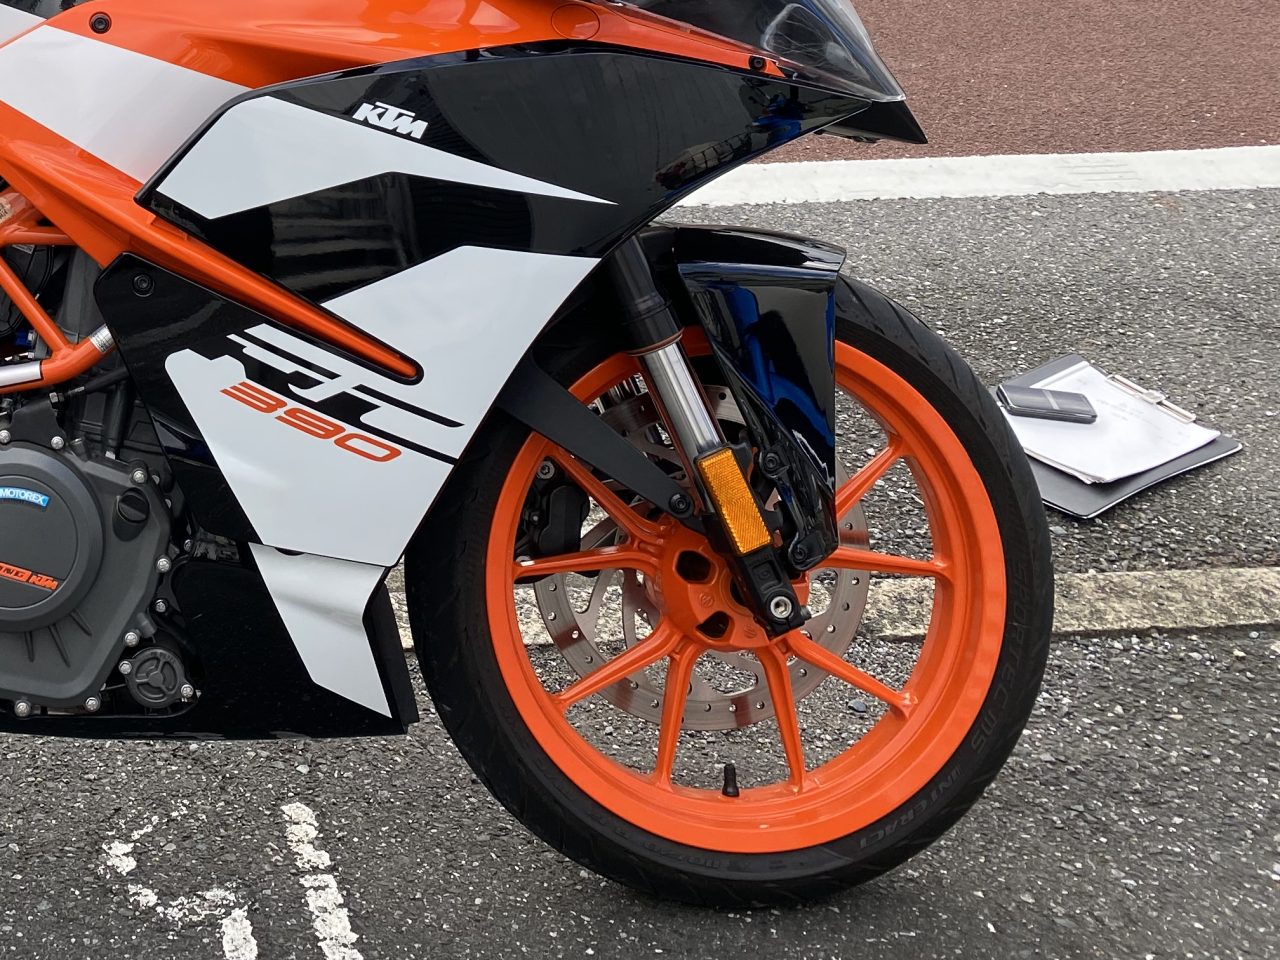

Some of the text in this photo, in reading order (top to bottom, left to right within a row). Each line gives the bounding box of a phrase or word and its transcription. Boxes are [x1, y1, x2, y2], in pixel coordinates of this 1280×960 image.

[352, 101, 429, 140] KTM
[220, 381, 402, 462] 390
[0, 488, 44, 505] MOTOREX
[28, 573, 59, 590] KTM
